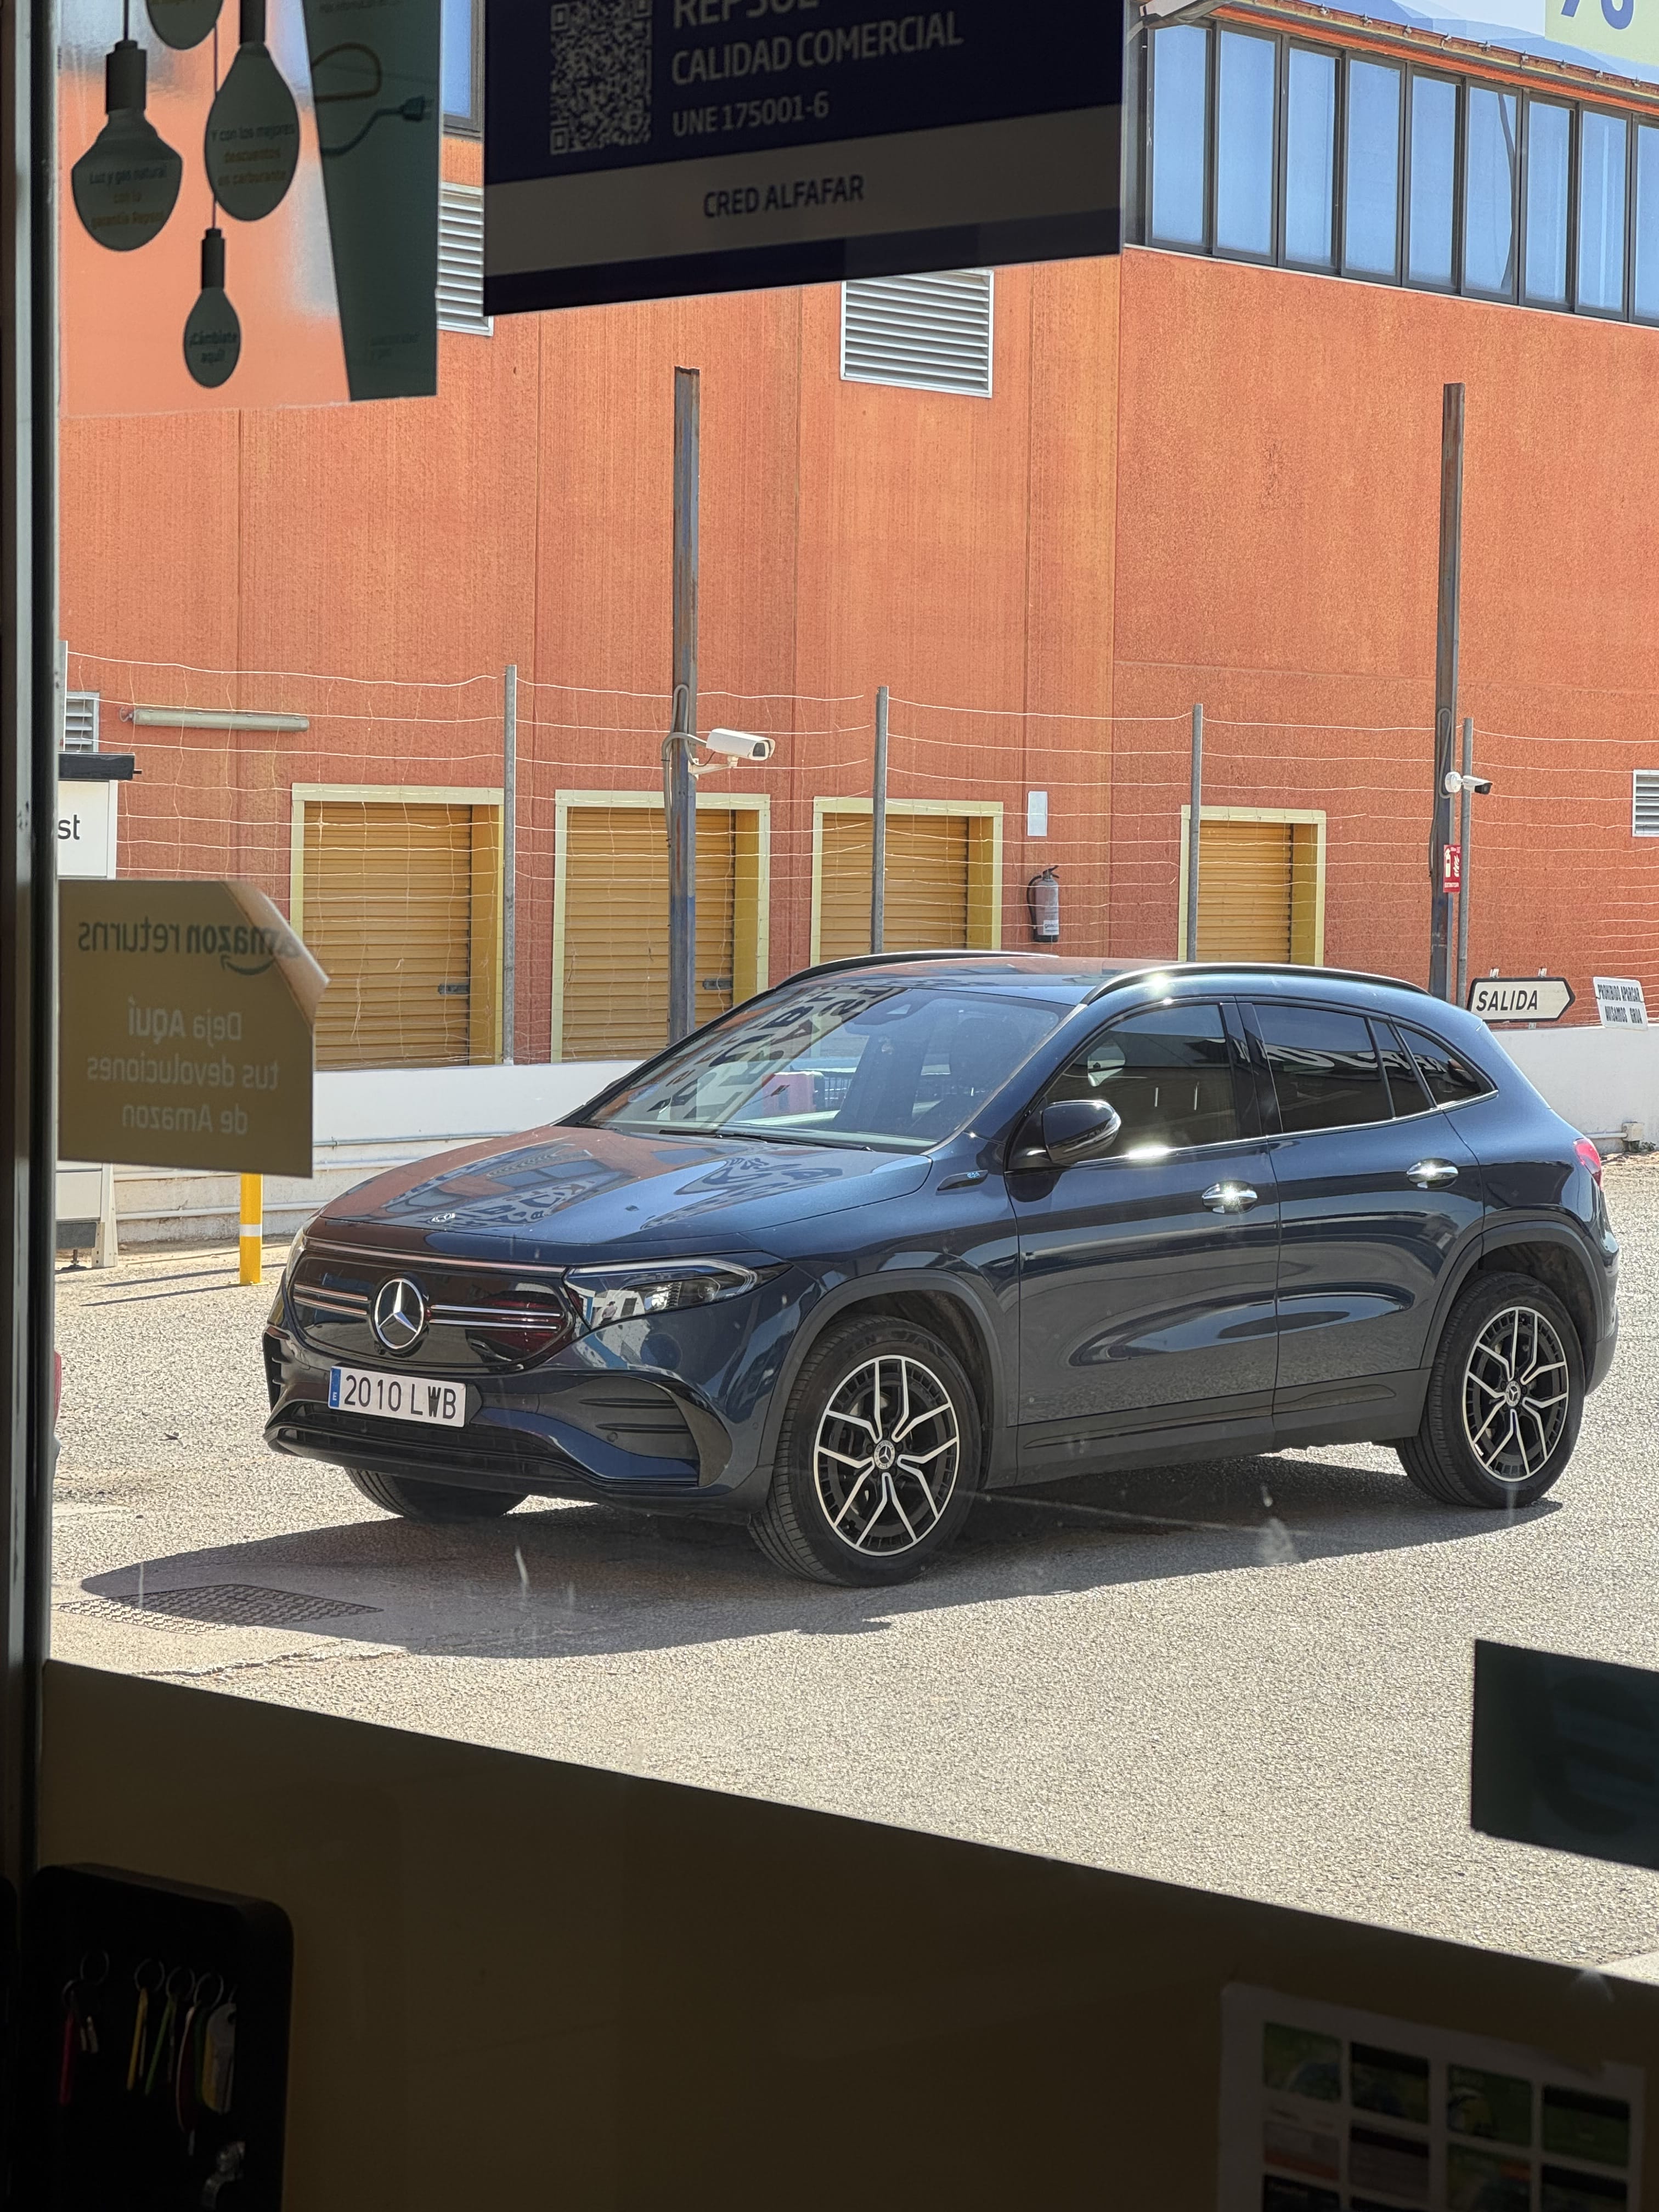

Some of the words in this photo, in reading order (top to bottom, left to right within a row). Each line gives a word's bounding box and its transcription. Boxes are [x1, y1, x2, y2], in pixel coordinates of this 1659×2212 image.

[673, 0, 820, 28] REPS
[673, 37, 793, 85] CALIDAD
[797, 11, 964, 69] COMERCIAL
[673, 106, 718, 137] UNE
[723, 91, 830, 129] 175001-6
[703, 187, 760, 218] CRED
[763, 174, 865, 213] ALFAFAR
[1476, 990, 1538, 1012] SALIDA
[332, 1391, 337, 1401] E
[344, 1375, 402, 1412] 2010
[410, 1384, 456, 1420] LWB
